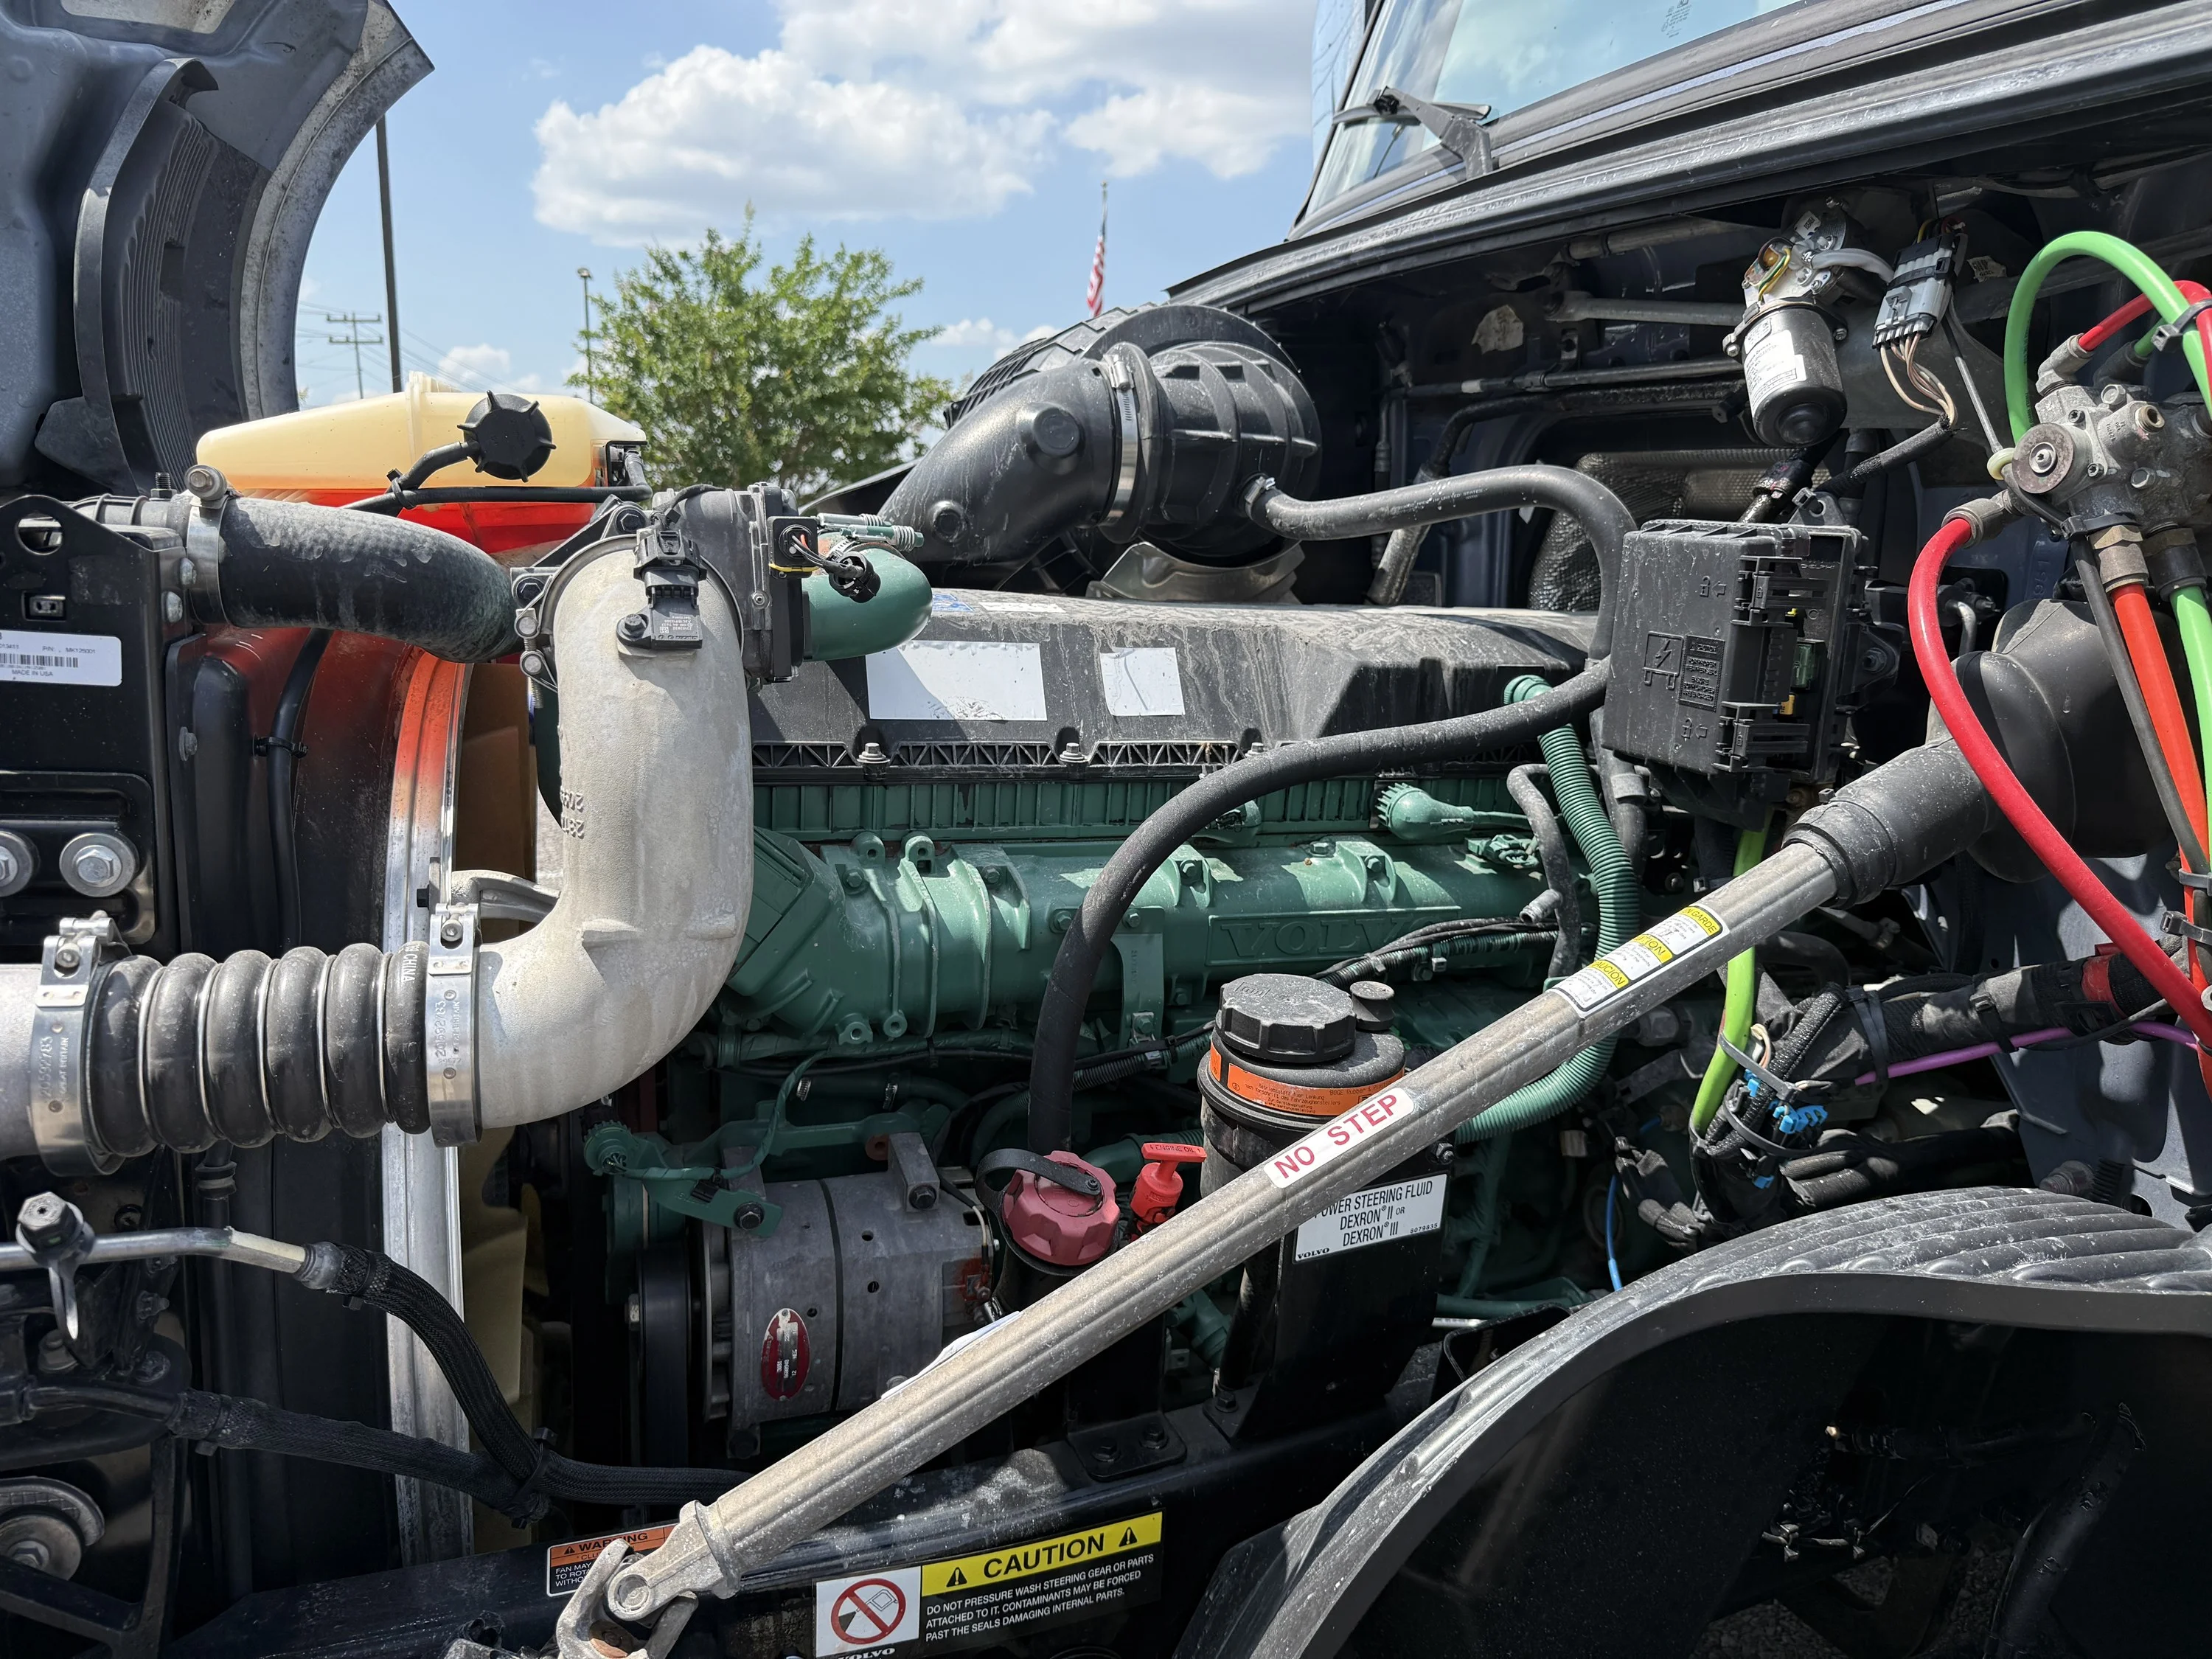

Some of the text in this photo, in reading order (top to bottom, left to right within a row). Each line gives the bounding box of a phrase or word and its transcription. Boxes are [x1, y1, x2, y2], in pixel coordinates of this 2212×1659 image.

[401, 953, 418, 983] CHINA
[1274, 1094, 1397, 1178] NO STEP
[1315, 1180, 1433, 1219] OWER STEERING FLUID
[1387, 1206, 1394, 1220] II
[1396, 1206, 1405, 1215] OR
[1389, 1221, 1399, 1236] III
[1410, 1222, 1438, 1234] 8079835
[1297, 1248, 1329, 1259] VOLVO
[555, 1562, 592, 1574] FAN MAY
[984, 1532, 1105, 1579] CAUTION
[926, 1570, 1141, 1630] ATTACHED TO IT. CONTAMINANTS MAY BE FORCED
[927, 1554, 1154, 1615] DO NOT PRESSURE WASH STEERING GEAR OR PARTS
[925, 1587, 1125, 1642] PAST THE SEALS DAMAGING INTERNAL PARTS.
